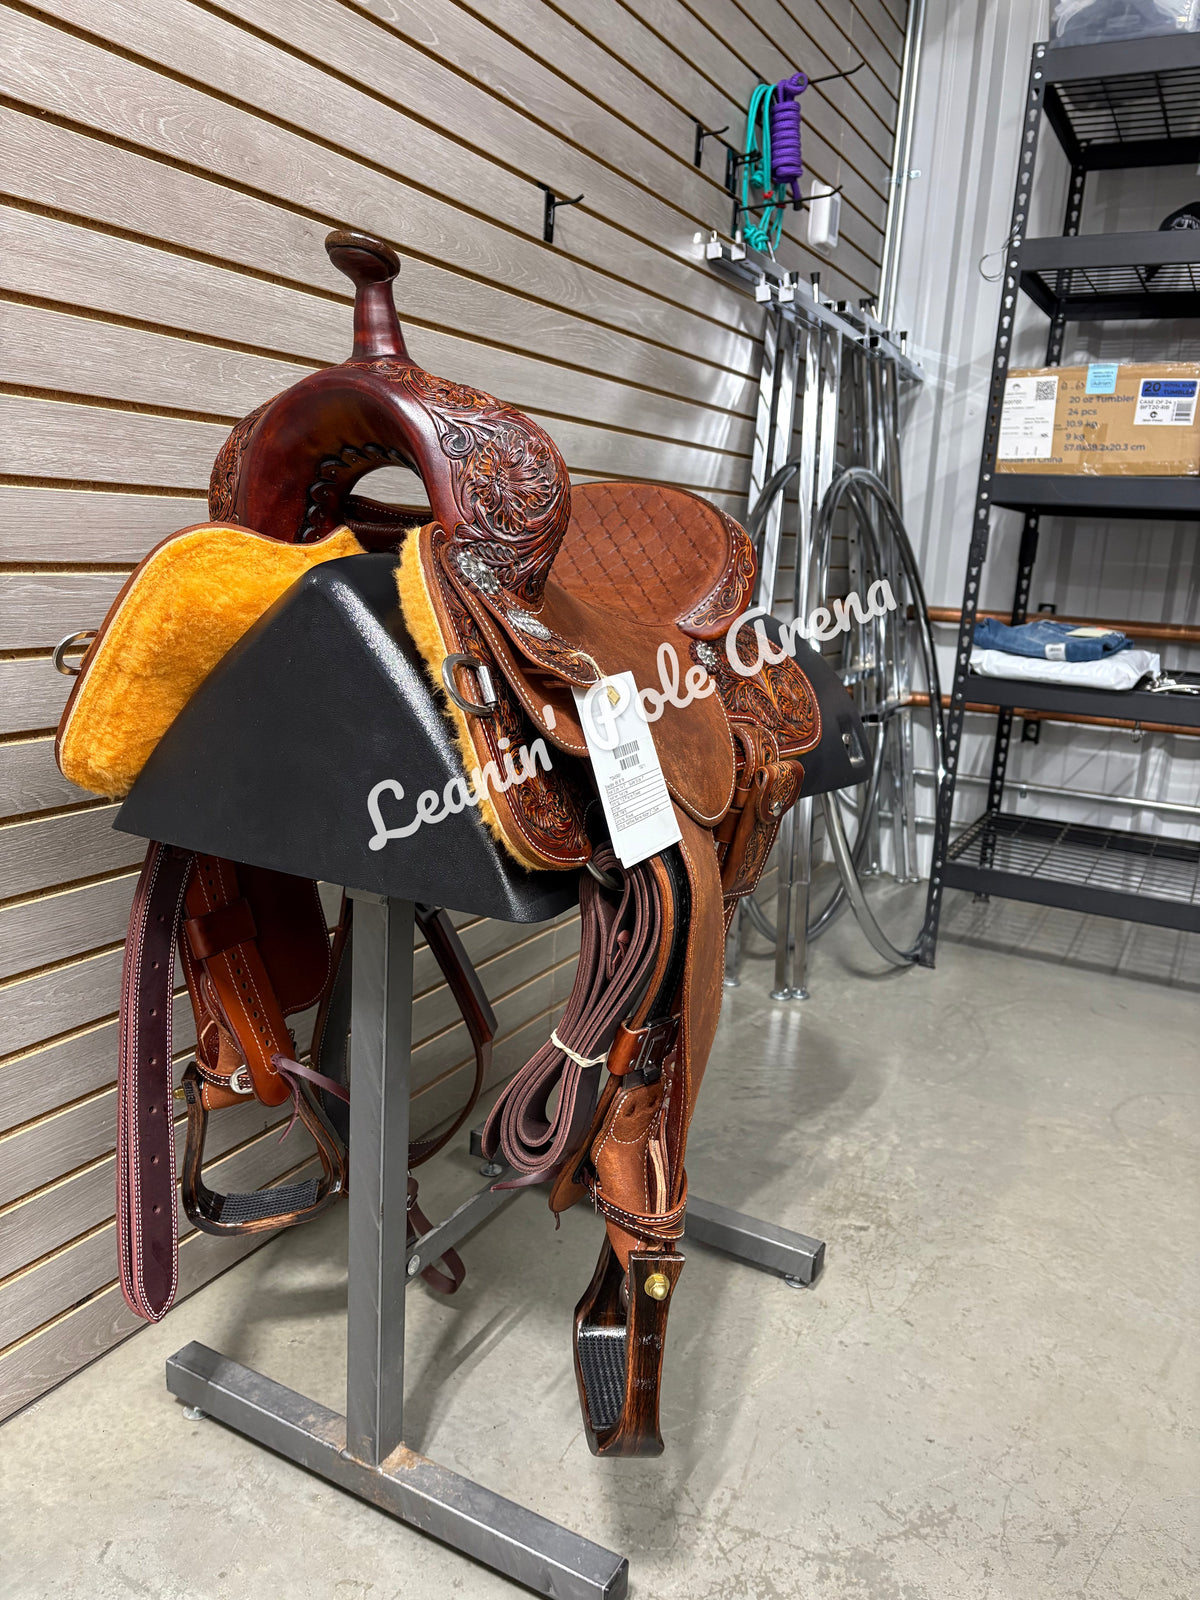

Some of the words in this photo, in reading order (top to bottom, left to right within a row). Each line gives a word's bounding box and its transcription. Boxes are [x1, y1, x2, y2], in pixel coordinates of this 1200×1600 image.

[1144, 382, 1162, 393] 20
[1069, 396, 1081, 404] 20
[1096, 395, 1135, 403] Tumbler
[1081, 408, 1098, 416] pcs
[1066, 420, 1084, 428] 10.9
[1085, 420, 1098, 429] kg
[1073, 433, 1086, 441] kg
